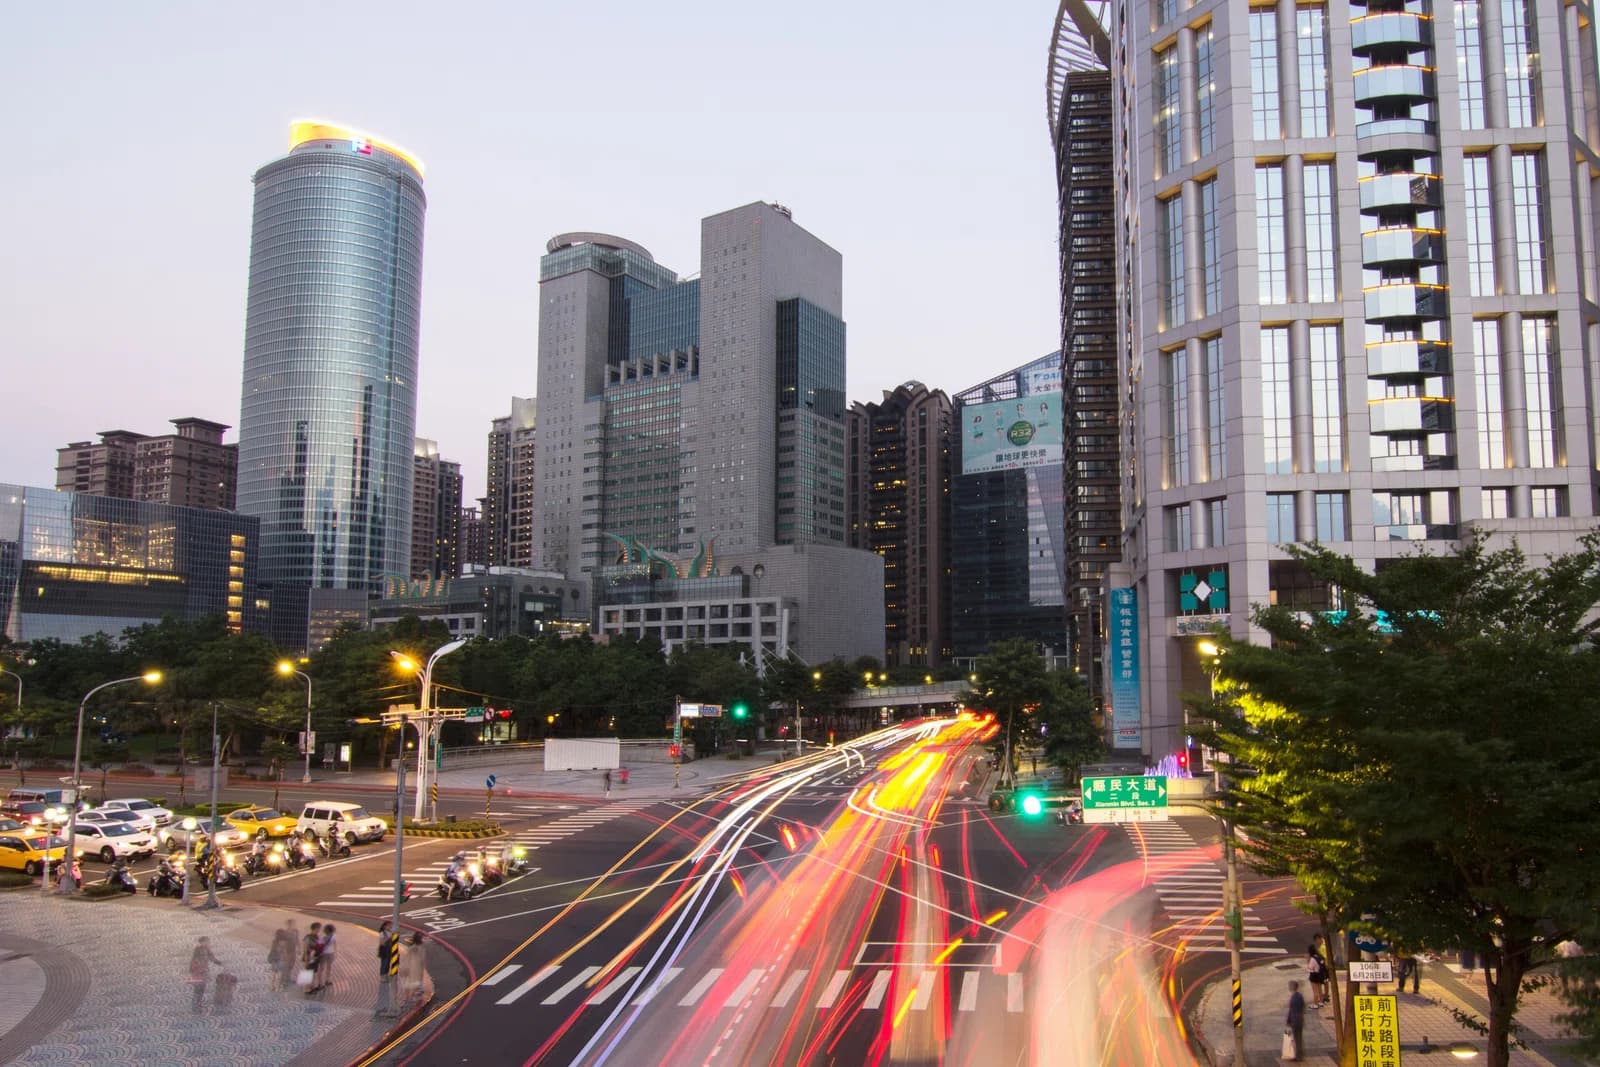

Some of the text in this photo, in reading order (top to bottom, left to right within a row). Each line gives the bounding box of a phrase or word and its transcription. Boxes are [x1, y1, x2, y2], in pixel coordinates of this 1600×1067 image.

[1011, 428, 1031, 438] R32
[1093, 778, 1156, 792] 縣民大道
[1352, 971, 1390, 979] 6月28日起
